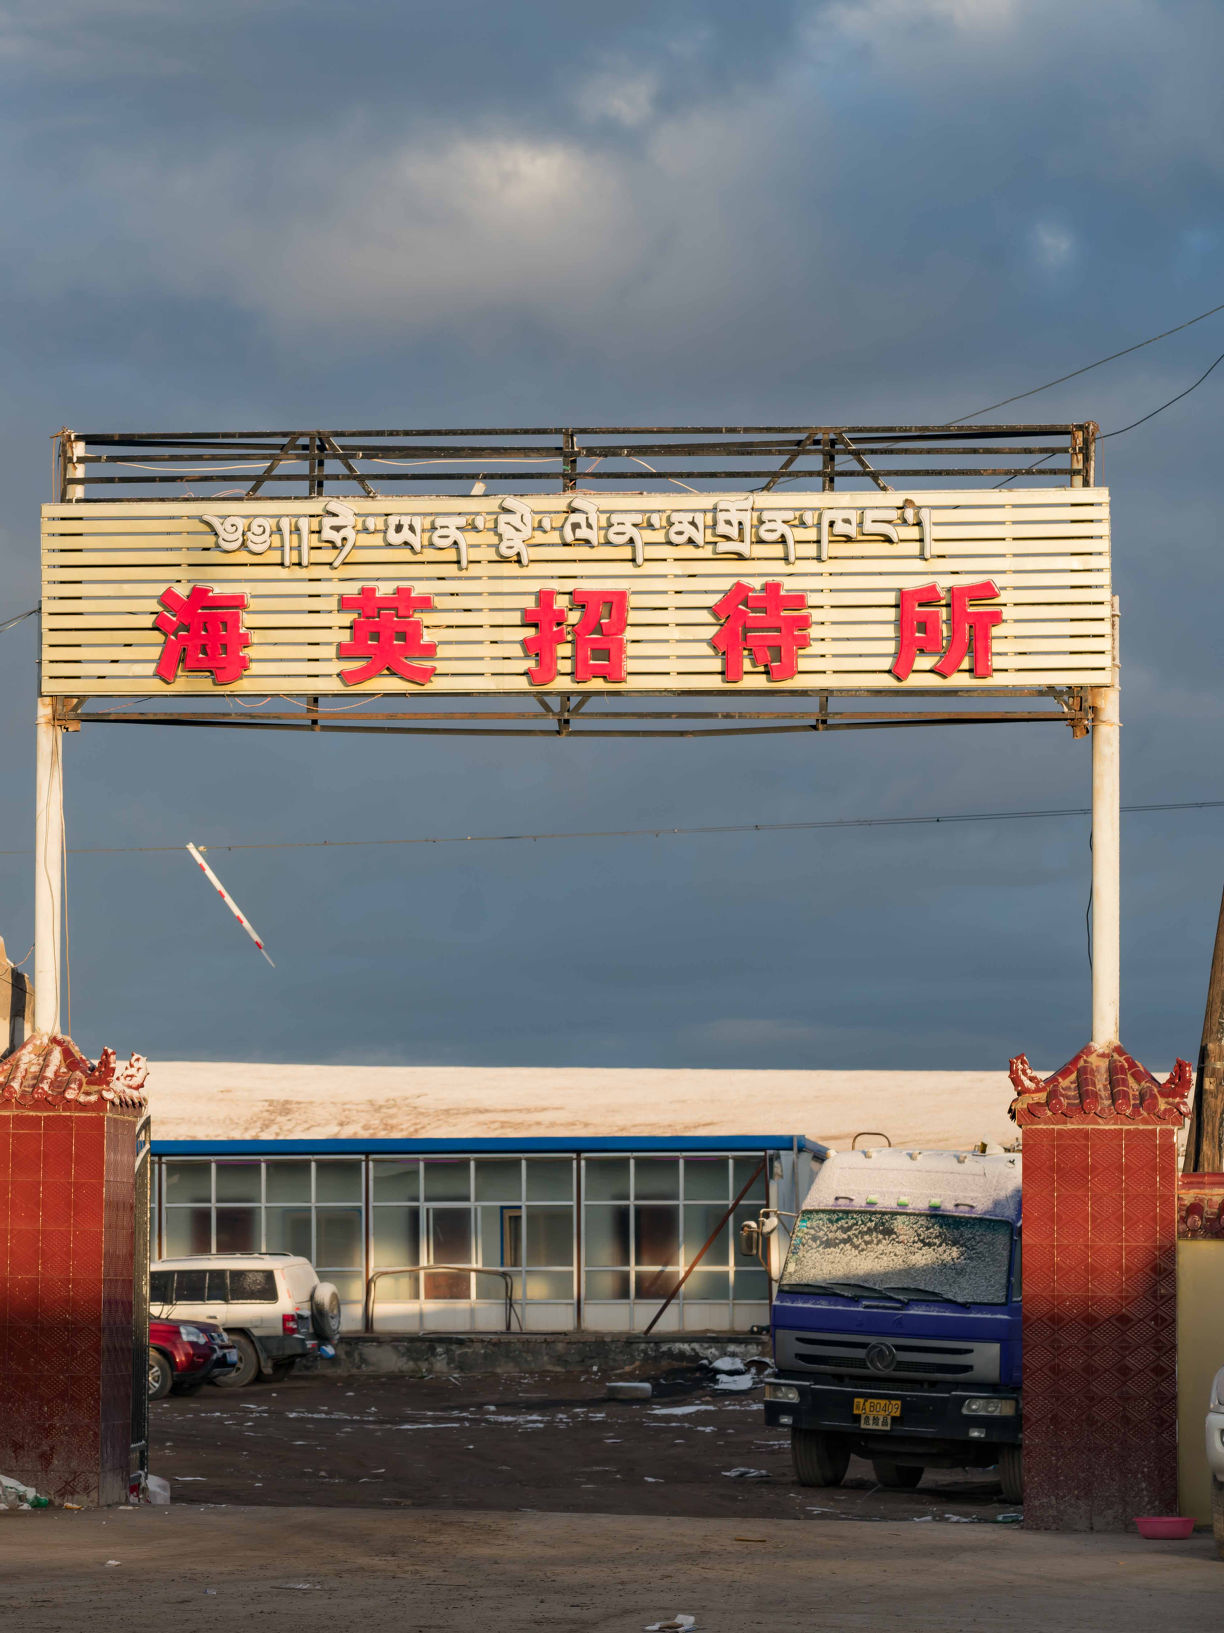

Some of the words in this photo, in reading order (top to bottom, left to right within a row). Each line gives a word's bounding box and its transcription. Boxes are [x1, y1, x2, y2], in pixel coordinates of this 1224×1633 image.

[154, 580, 1004, 686] 海英招待所
